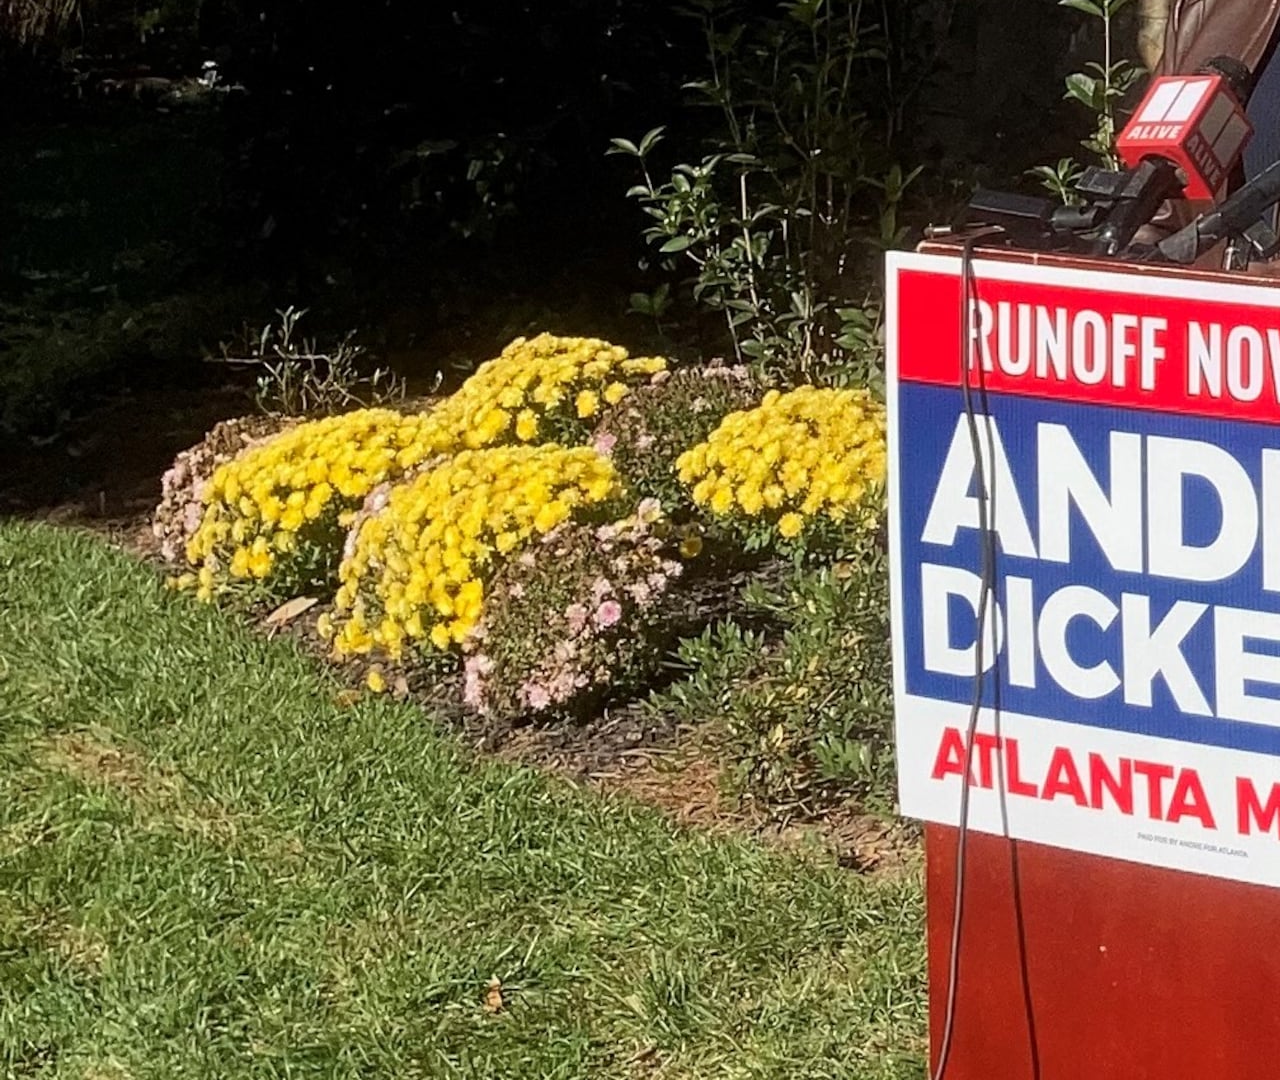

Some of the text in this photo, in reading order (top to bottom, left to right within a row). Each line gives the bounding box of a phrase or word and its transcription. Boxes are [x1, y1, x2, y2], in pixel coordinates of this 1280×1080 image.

[1126, 124, 1184, 140] ALIVE
[968, 301, 1166, 391] RUNOFF
[932, 727, 1217, 831] ATLANTA
